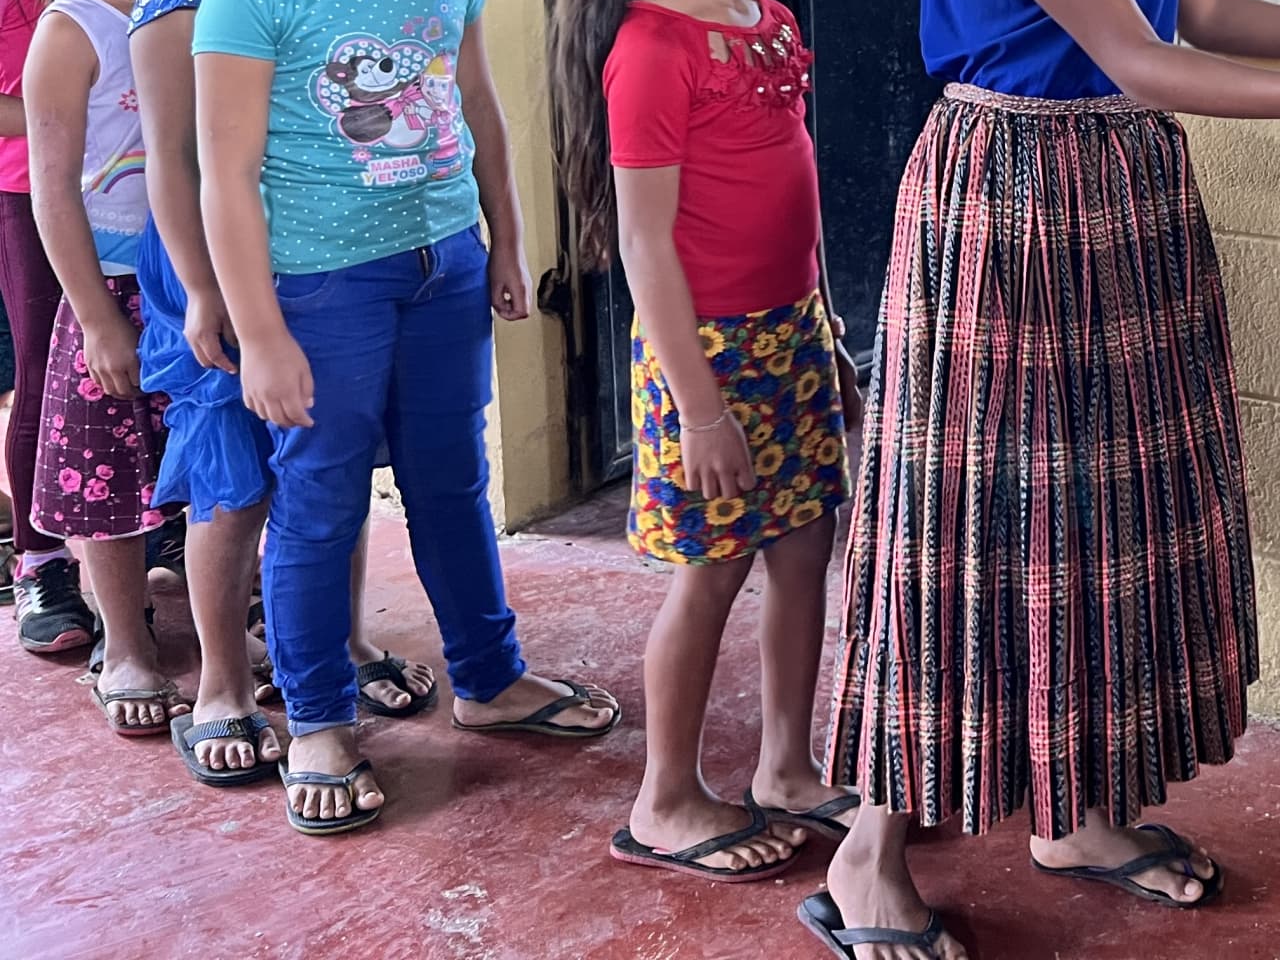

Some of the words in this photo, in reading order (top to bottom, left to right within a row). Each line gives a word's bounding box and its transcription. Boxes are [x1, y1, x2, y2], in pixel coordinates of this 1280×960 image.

[371, 157, 419, 172] MASHA
[364, 173, 374, 183] Y
[378, 173, 395, 182] EL
[399, 166, 425, 179] OSO
